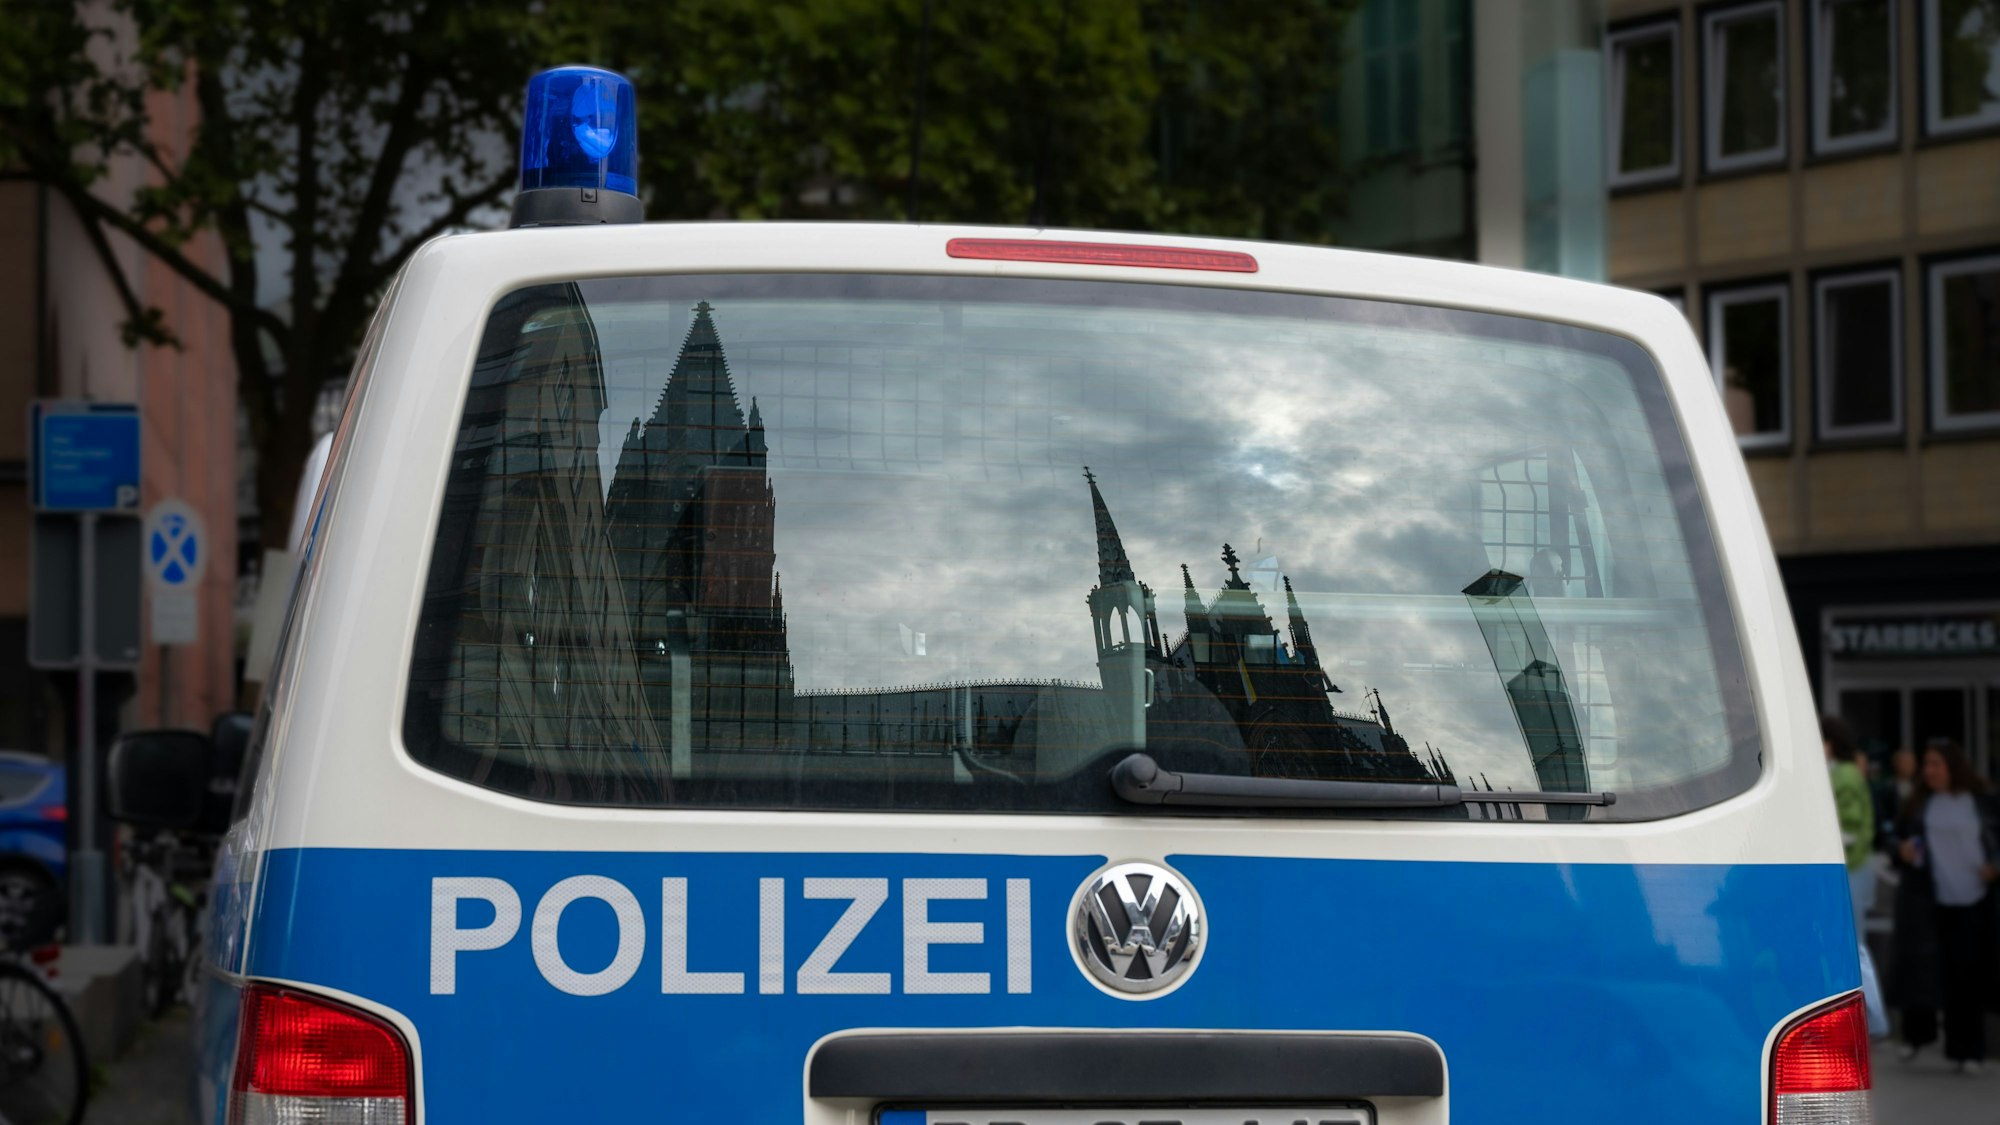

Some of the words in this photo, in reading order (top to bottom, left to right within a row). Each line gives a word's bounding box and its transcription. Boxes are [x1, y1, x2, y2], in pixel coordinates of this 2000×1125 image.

[116, 485, 138, 509] P
[1830, 621, 1995, 651] STARBUCKS
[430, 874, 1032, 997] POLIZEI
[1076, 865, 1198, 992] VW
